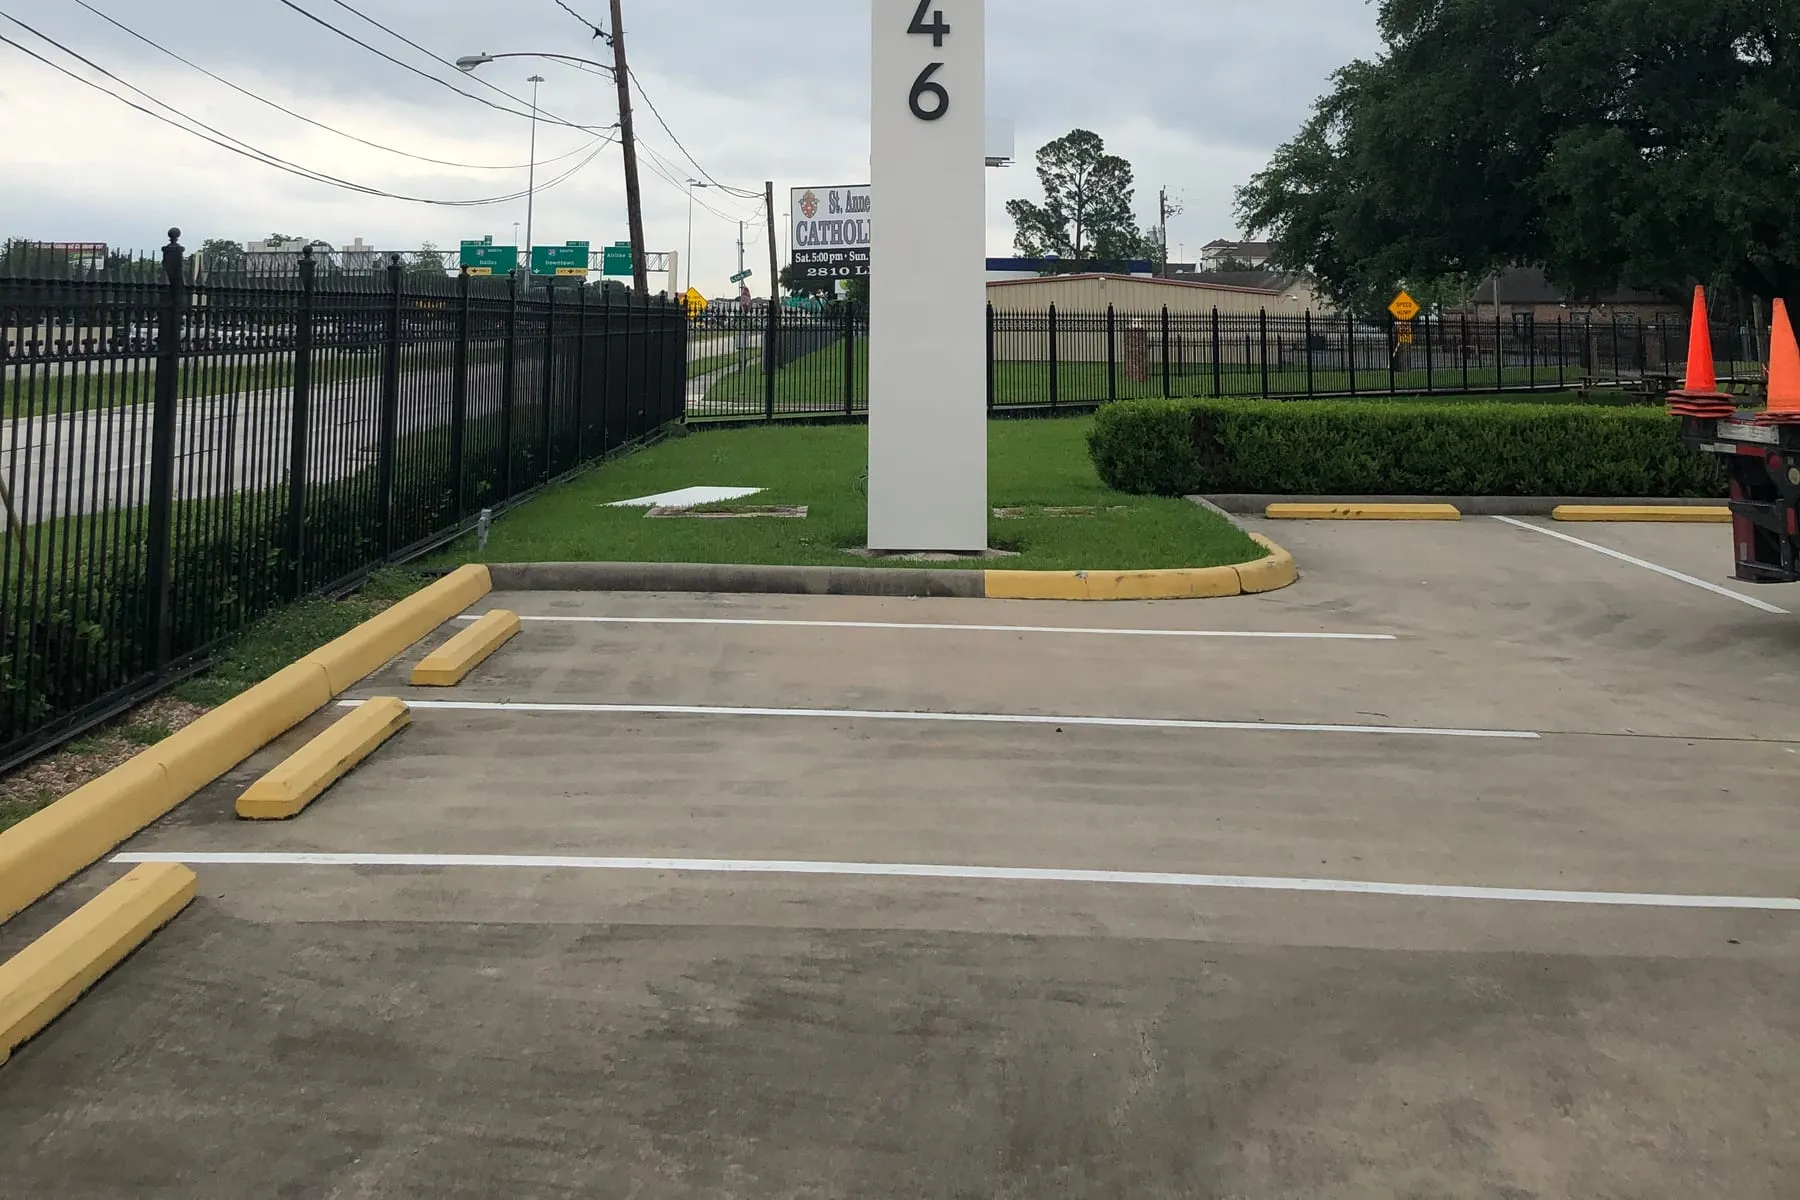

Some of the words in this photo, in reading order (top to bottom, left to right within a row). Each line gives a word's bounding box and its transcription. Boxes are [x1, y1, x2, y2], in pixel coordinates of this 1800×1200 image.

[828, 190, 843, 214] St.
[795, 252, 811, 263] Sat.
[807, 267, 850, 277] 2810
